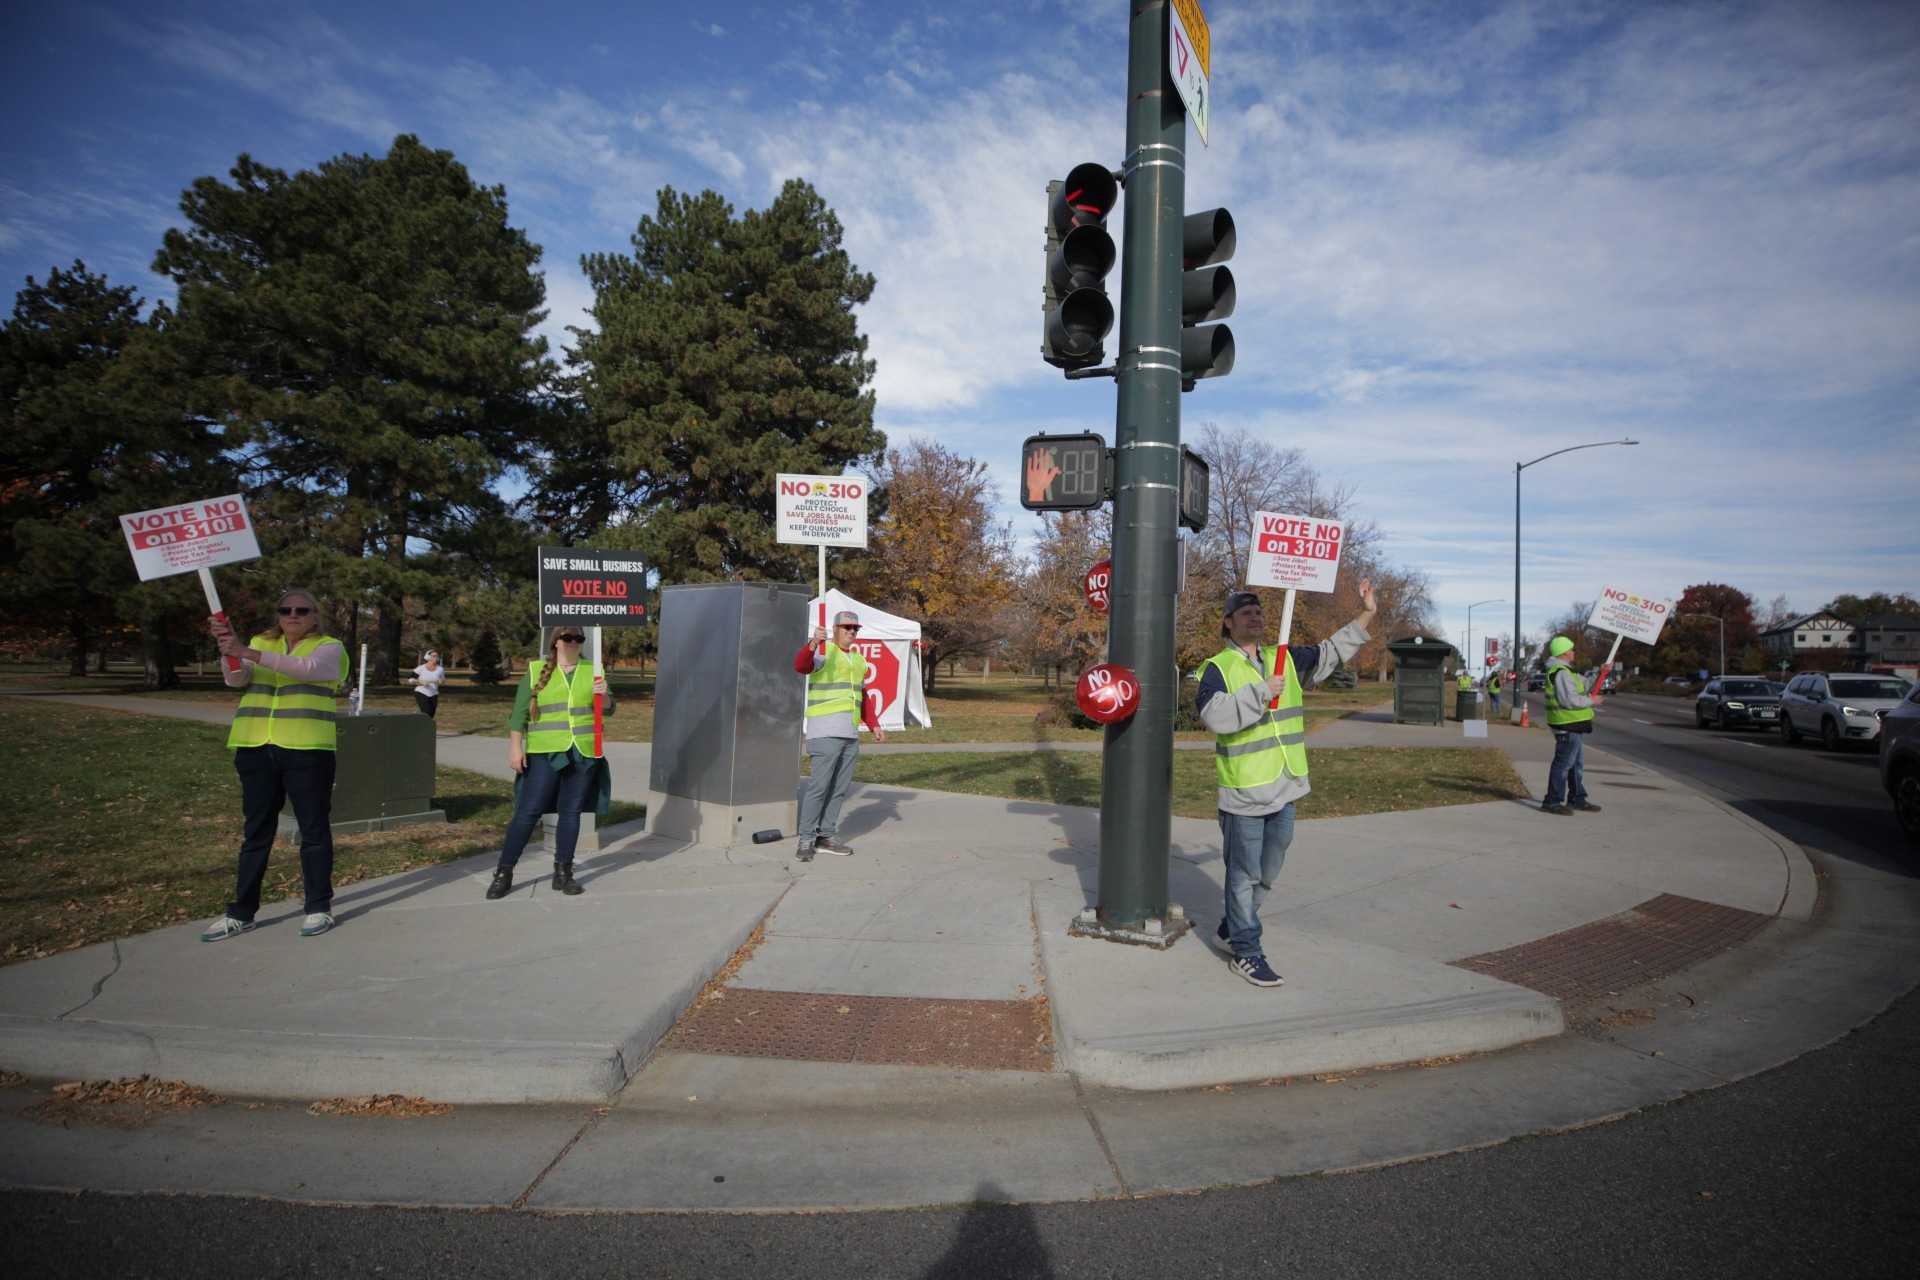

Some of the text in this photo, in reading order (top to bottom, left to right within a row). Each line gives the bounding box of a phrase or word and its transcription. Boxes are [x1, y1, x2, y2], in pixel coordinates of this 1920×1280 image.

[781, 481, 862, 499] NO 310
[127, 501, 240, 530] VOTE NO
[145, 517, 235, 546] on 310!
[1264, 517, 1341, 541] VOTE NO
[1267, 540, 1331, 558] on 310!
[544, 558, 643, 572] SAVE SMALL BUSINESS
[563, 580, 627, 597] VOTE NO
[1089, 574, 1108, 590] NO
[1089, 590, 1110, 610] 31
[1604, 588, 1666, 613] NO 310
[544, 604, 644, 616] ON REFERENDUM 310
[850, 644, 882, 658] OTE
[1088, 670, 1112, 690] NO
[1088, 680, 1133, 713] 310
